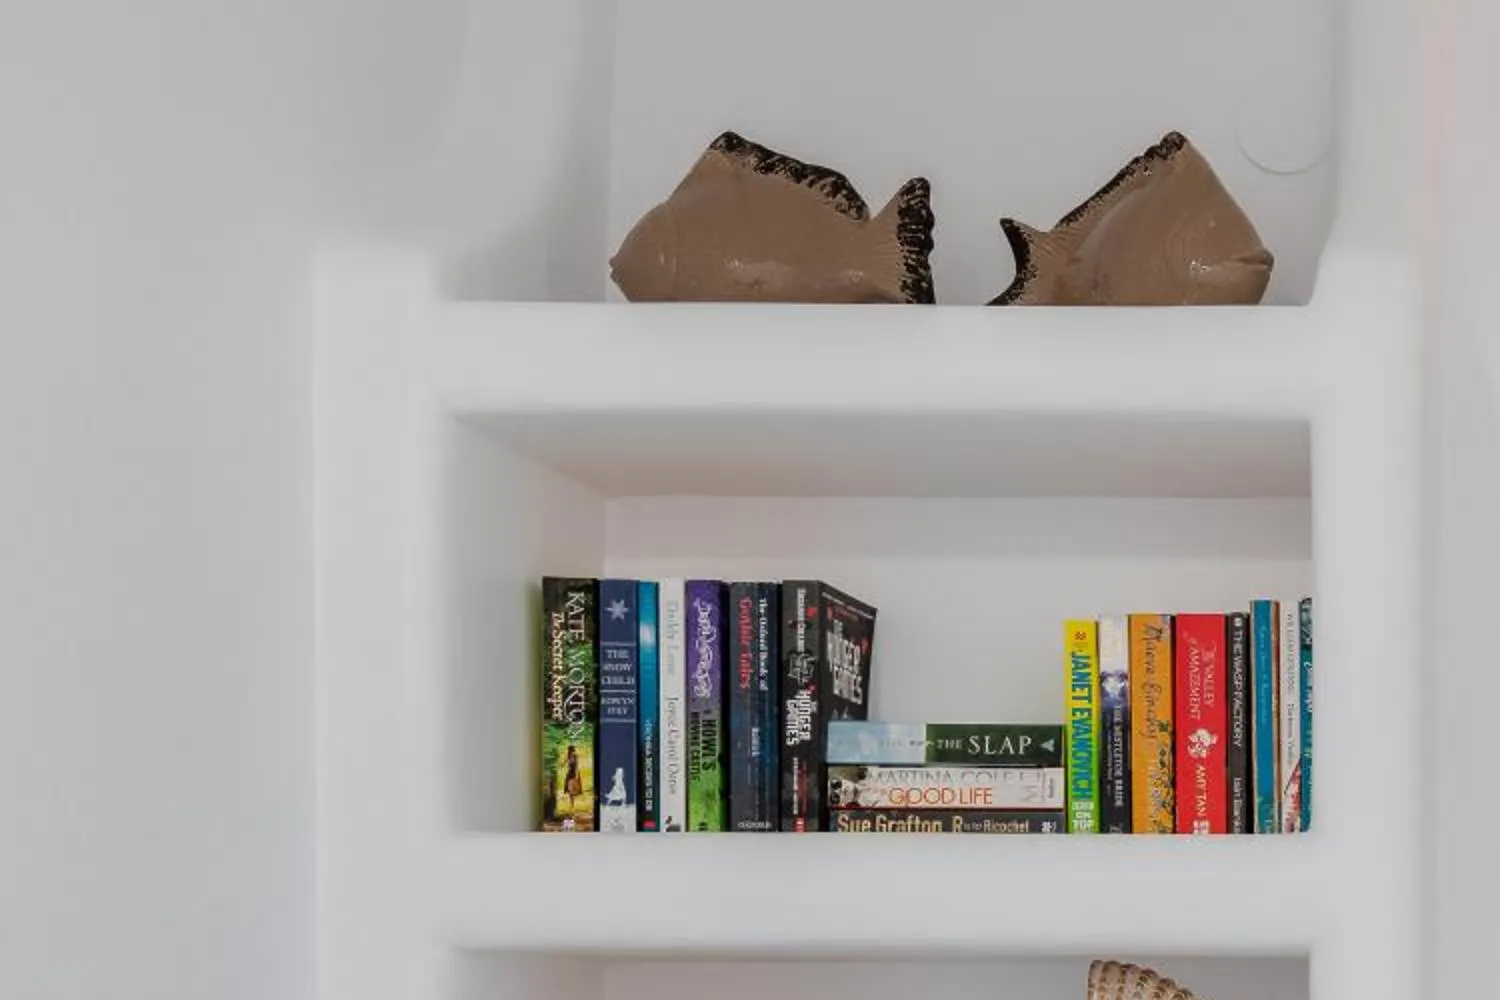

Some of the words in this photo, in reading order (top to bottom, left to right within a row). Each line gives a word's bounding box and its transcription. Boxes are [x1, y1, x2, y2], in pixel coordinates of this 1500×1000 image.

[566, 590, 586, 642] KATE
[550, 629, 565, 671] Secret
[1141, 624, 1166, 676] Maeve
[1233, 629, 1243, 654] THE
[547, 672, 565, 721] Keeper
[565, 648, 586, 740] MORTON
[1071, 652, 1092, 704] JANET
[1188, 645, 1202, 721] AMAZEMENT
[1203, 662, 1216, 709] VALLEY
[1233, 655, 1243, 690] WASP
[785, 698, 799, 746] GAMES
[797, 689, 812, 741] HUNGER
[1138, 682, 1163, 740] Binchy
[1233, 691, 1243, 748] FACTORY
[935, 738, 963, 749] THE
[967, 735, 1032, 756] SLAP
[1071, 707, 1092, 800] EVANOVICH
[888, 786, 956, 806] GOOD
[959, 787, 994, 805] LIFE
[1195, 763, 1208, 791] AMY
[836, 814, 871, 833] Sue
[874, 813, 943, 833] Grafton
[951, 815, 963, 832] R
[983, 818, 1030, 833] Ricochet
[1195, 792, 1208, 817] TAN
